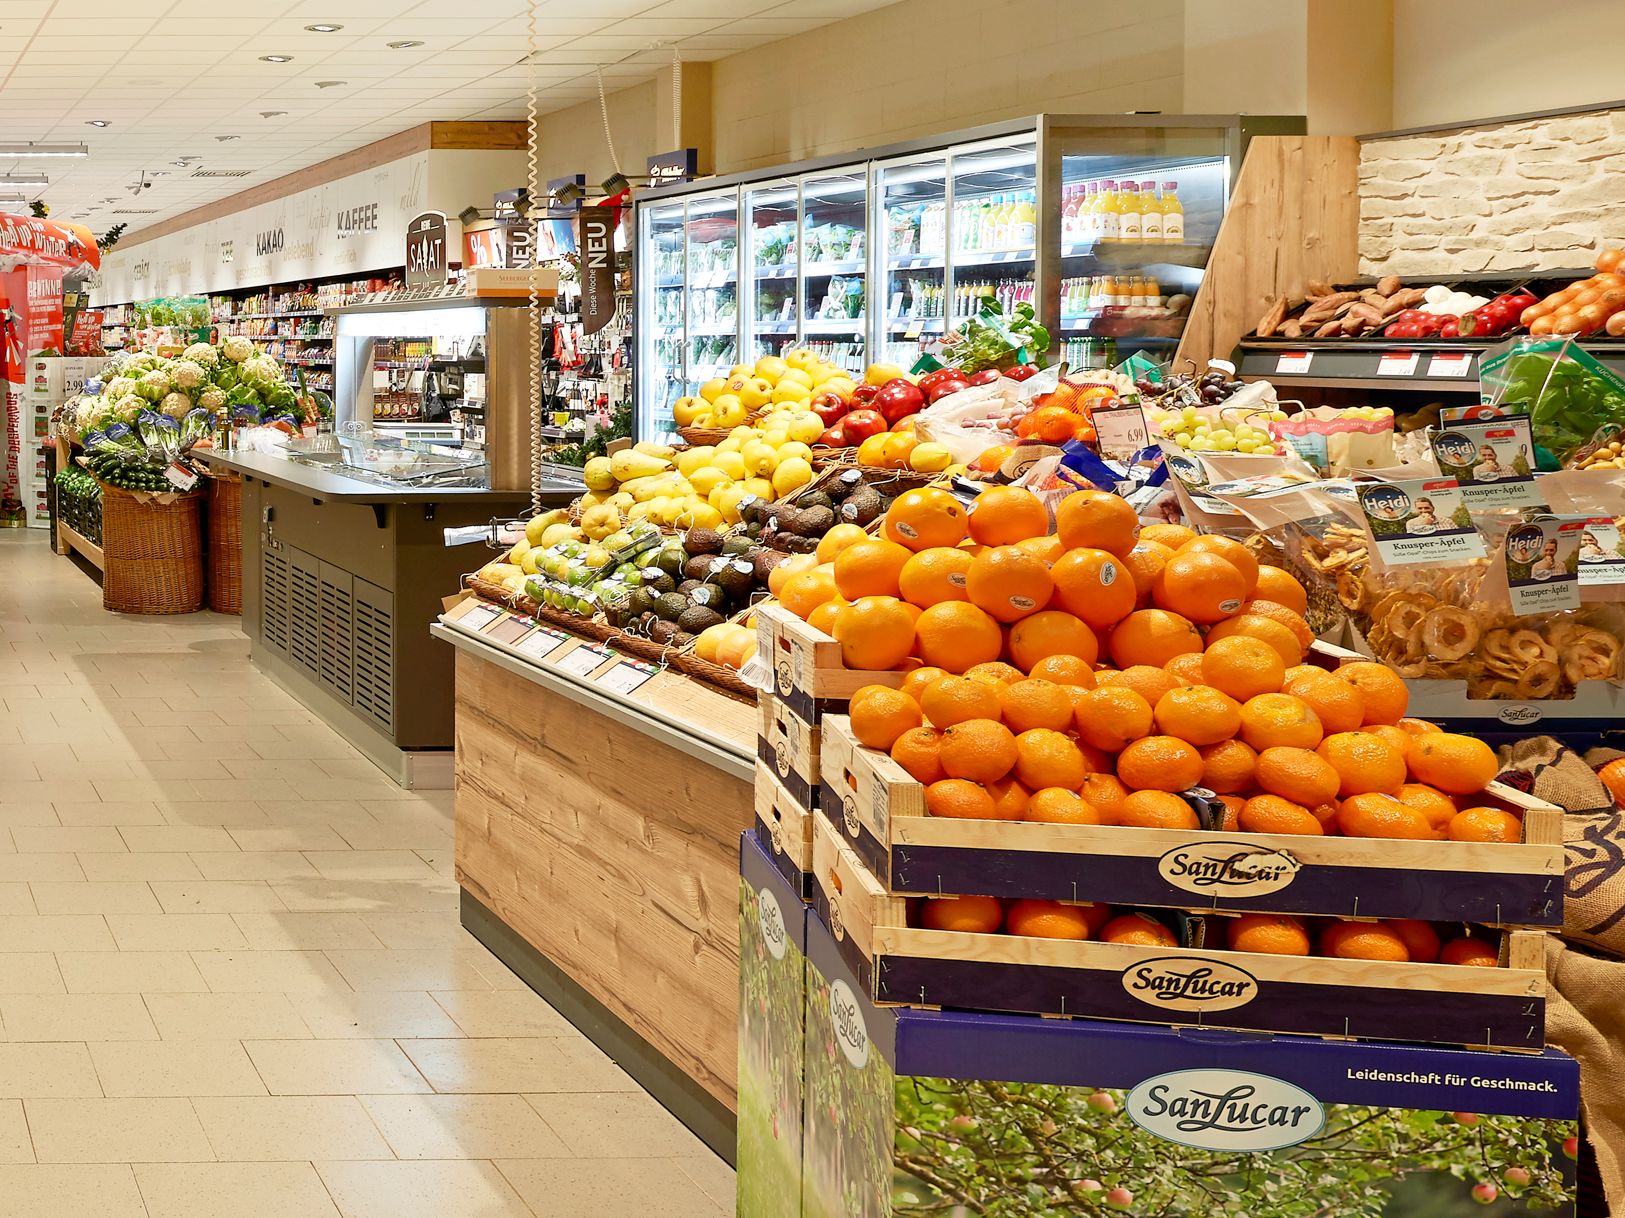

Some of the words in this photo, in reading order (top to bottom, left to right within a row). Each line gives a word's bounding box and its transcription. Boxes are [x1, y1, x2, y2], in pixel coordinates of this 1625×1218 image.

[337, 202, 378, 239] KAFFEE
[256, 228, 284, 256] KAKAO
[587, 222, 607, 268] NEU
[588, 269, 597, 294] Woche
[589, 295, 598, 316] Diese
[66, 380, 83, 391] 2.99
[1127, 428, 1143, 442] 6.99
[1435, 442, 1475, 456] Heidi
[1462, 485, 1526, 497] Knusper-Äpfel
[1364, 495, 1410, 511] Heidi
[1393, 537, 1466, 550] Knusper-Äpfel
[1509, 535, 1543, 551] Heidi
[1520, 584, 1569, 598] Knusper-Äpfel
[1501, 707, 1540, 722] SanLucar
[1132, 967, 1251, 1000] SanLucar
[833, 989, 866, 1053] SanLucar
[1347, 1068, 1442, 1085] Leidenschaft
[1444, 1074, 1467, 1086] für
[1470, 1076, 1558, 1093] Geschmack.
[1142, 1084, 1311, 1132] SanLucar
